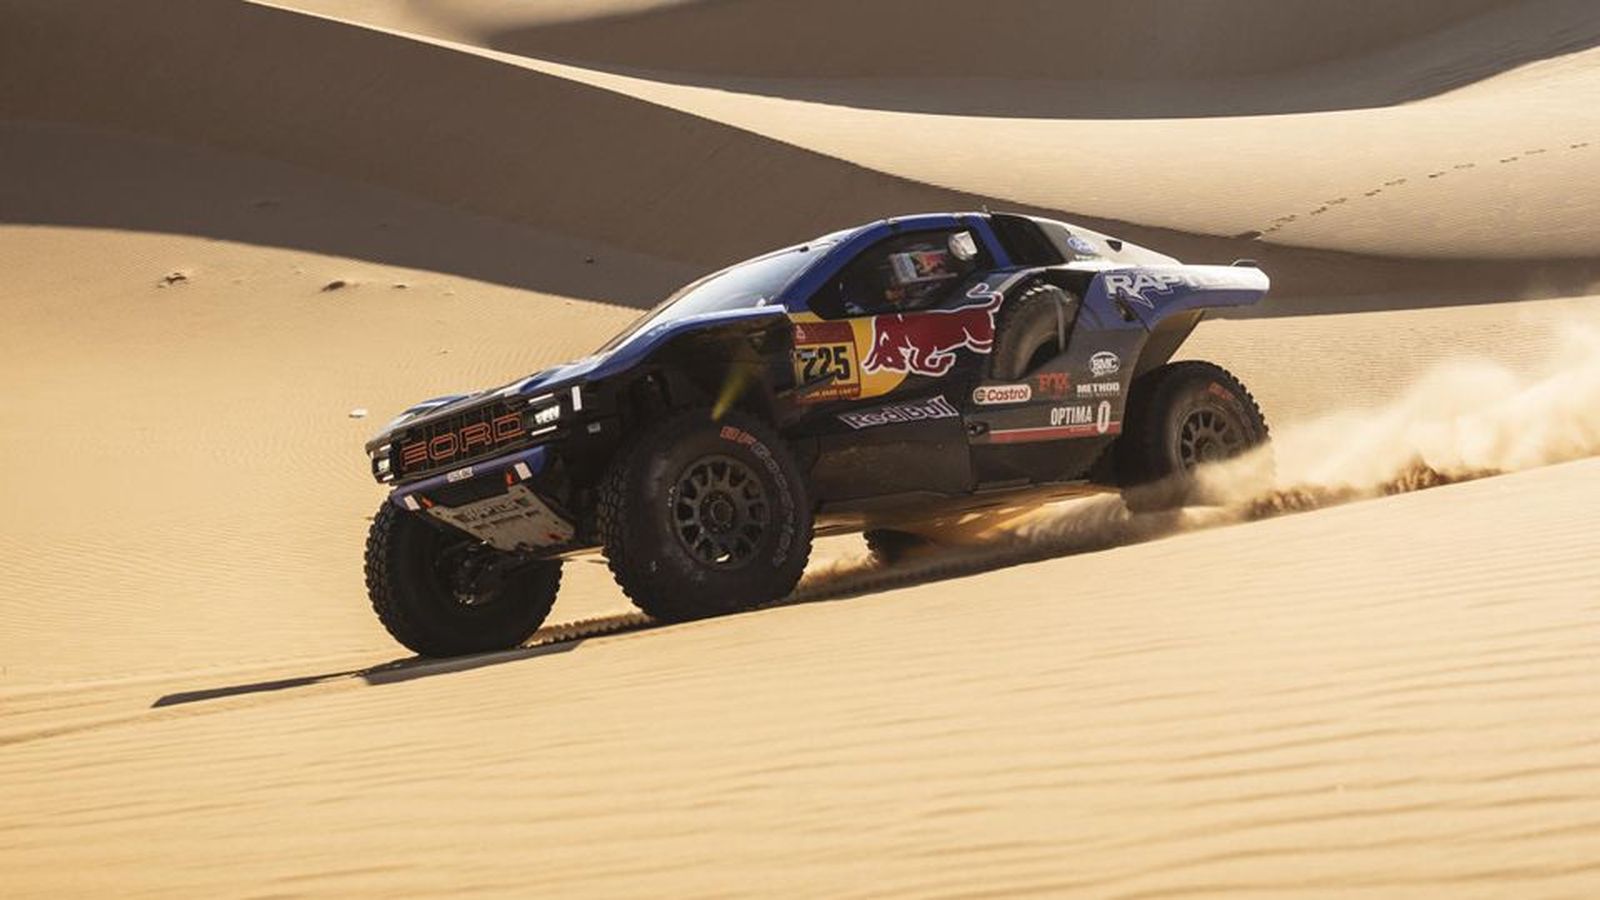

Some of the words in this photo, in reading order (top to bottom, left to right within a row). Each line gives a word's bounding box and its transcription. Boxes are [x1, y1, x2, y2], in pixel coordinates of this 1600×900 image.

[797, 346, 850, 384] 225
[987, 387, 1029, 402] Castrol
[1076, 382, 1120, 393] METHOD
[1050, 405, 1092, 426] OPTIMA
[401, 411, 526, 467] FORD
